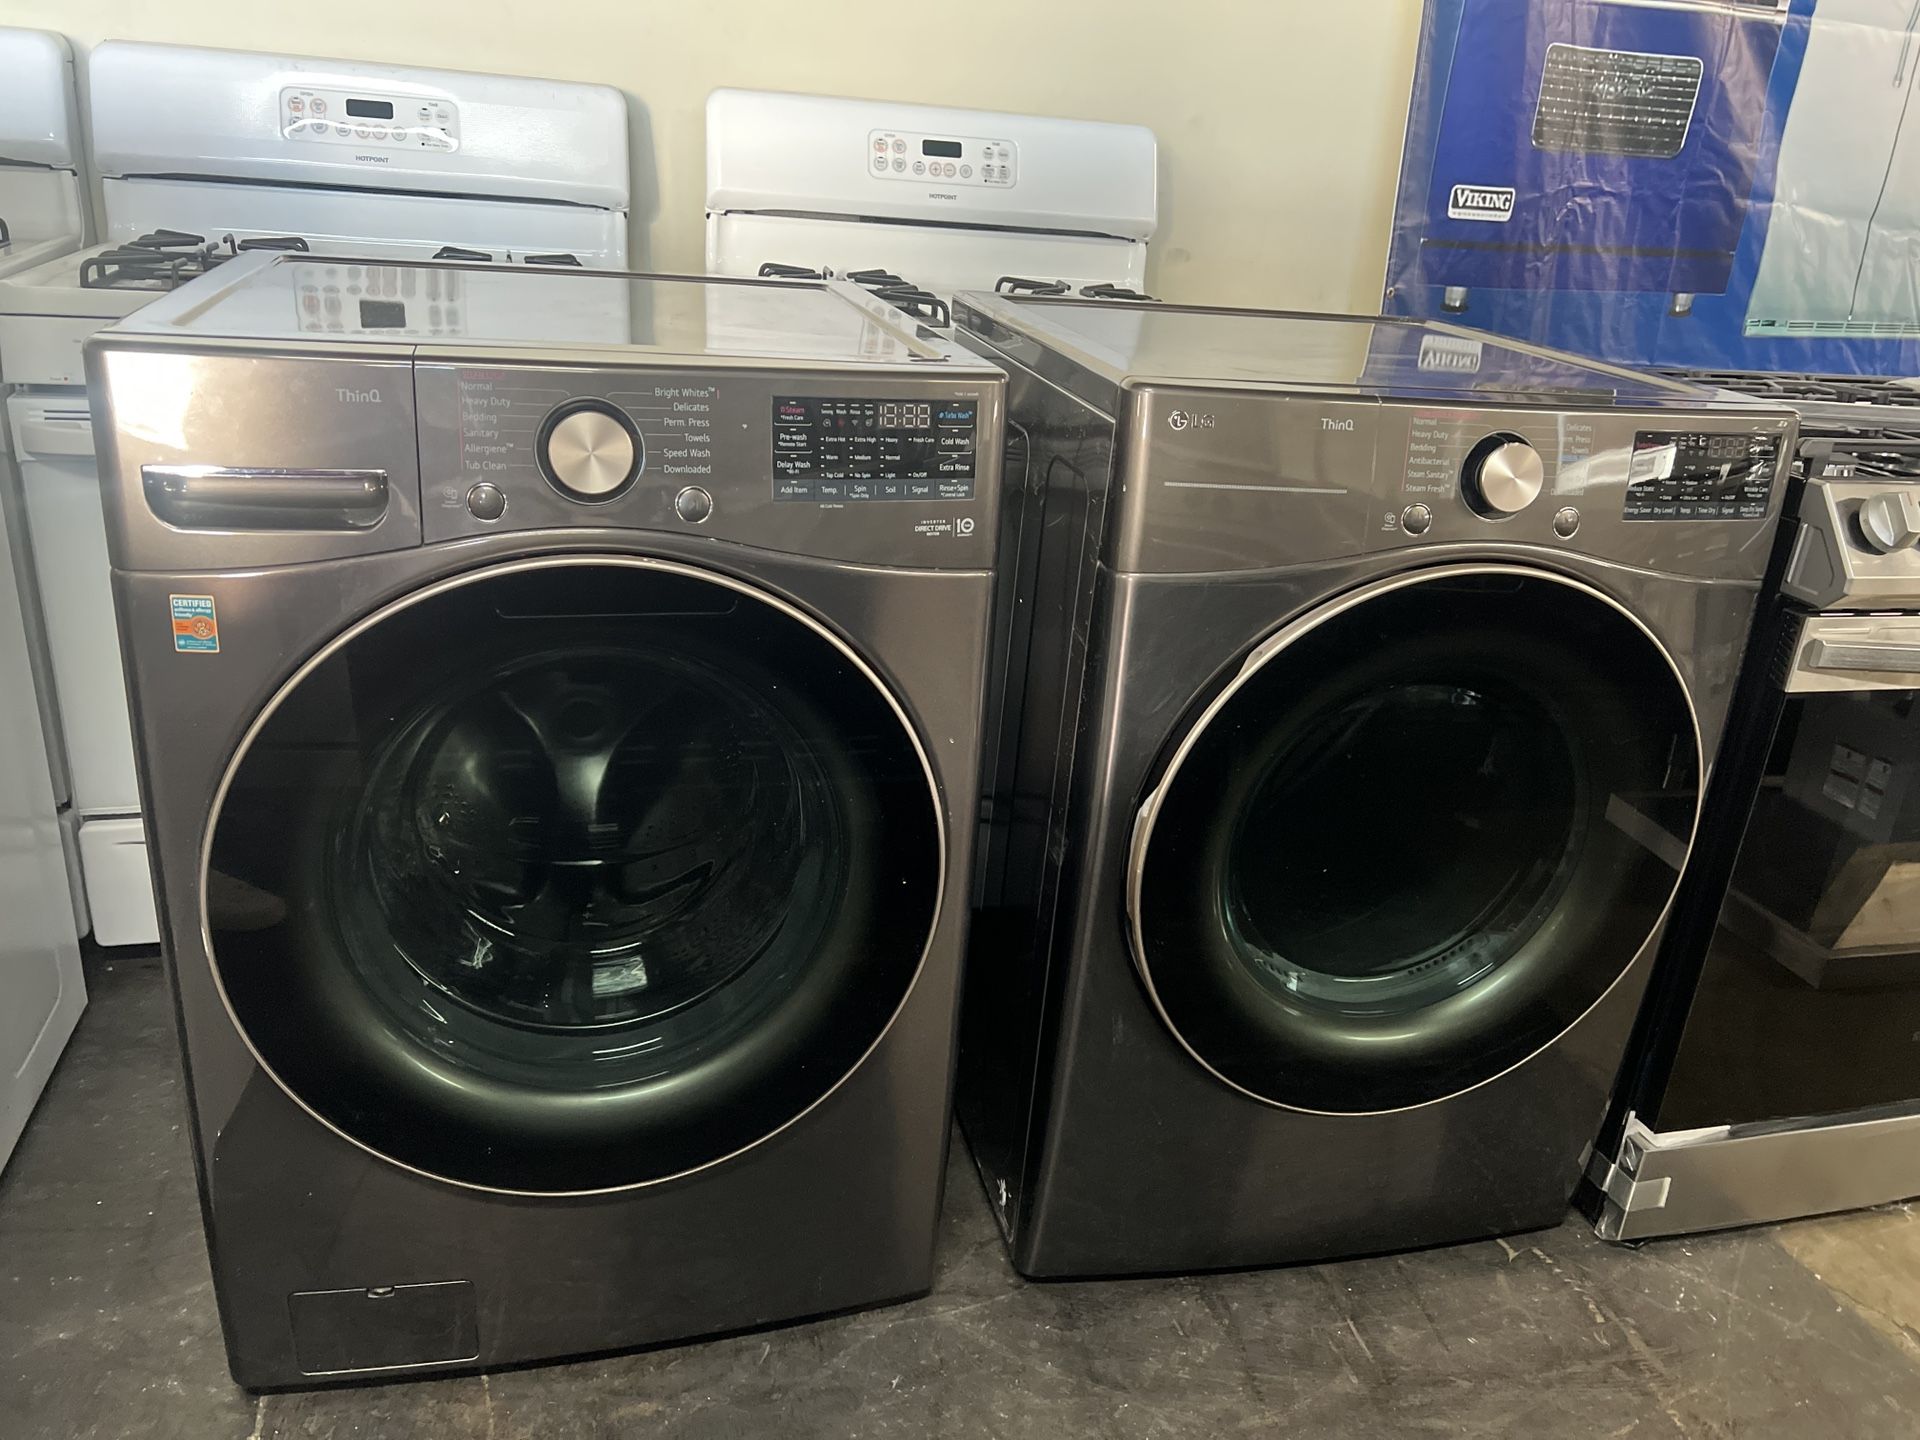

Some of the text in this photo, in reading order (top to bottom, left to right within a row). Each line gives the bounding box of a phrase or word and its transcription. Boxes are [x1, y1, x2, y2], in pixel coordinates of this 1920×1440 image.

[355, 155, 389, 163] HOTPOINT
[929, 193, 957, 201] HOTPOINT
[1456, 188, 1511, 210] VIKING
[460, 381, 492, 391] Normal
[335, 388, 382, 403] ThinQ
[654, 387, 680, 399] Bright
[490, 397, 511, 408] Duty
[673, 402, 710, 412] Delicates
[463, 412, 497, 423] Bedding
[688, 418, 710, 427] Press
[1412, 417, 1438, 426] Normal
[1321, 417, 1354, 431] ThinQ
[463, 428, 499, 439] Sanitary
[684, 433, 711, 443] Towels
[779, 432, 808, 441] Pre-wash
[1411, 430, 1449, 440] Heavy Duty
[1410, 443, 1437, 453] Bedding
[663, 448, 711, 459] Speed Wash
[465, 460, 507, 471] Tub Clean
[776, 460, 811, 469] Delay Wash
[1408, 456, 1450, 466] Antibacterial
[663, 464, 711, 474] Downloaded
[939, 463, 970, 471] Extra Rinse
[853, 485, 867, 493] Spin
[911, 486, 929, 494] Signal
[1405, 483, 1426, 493] Steam
[956, 517, 975, 533] 10
[173, 599, 212, 608] CERTIFIED
